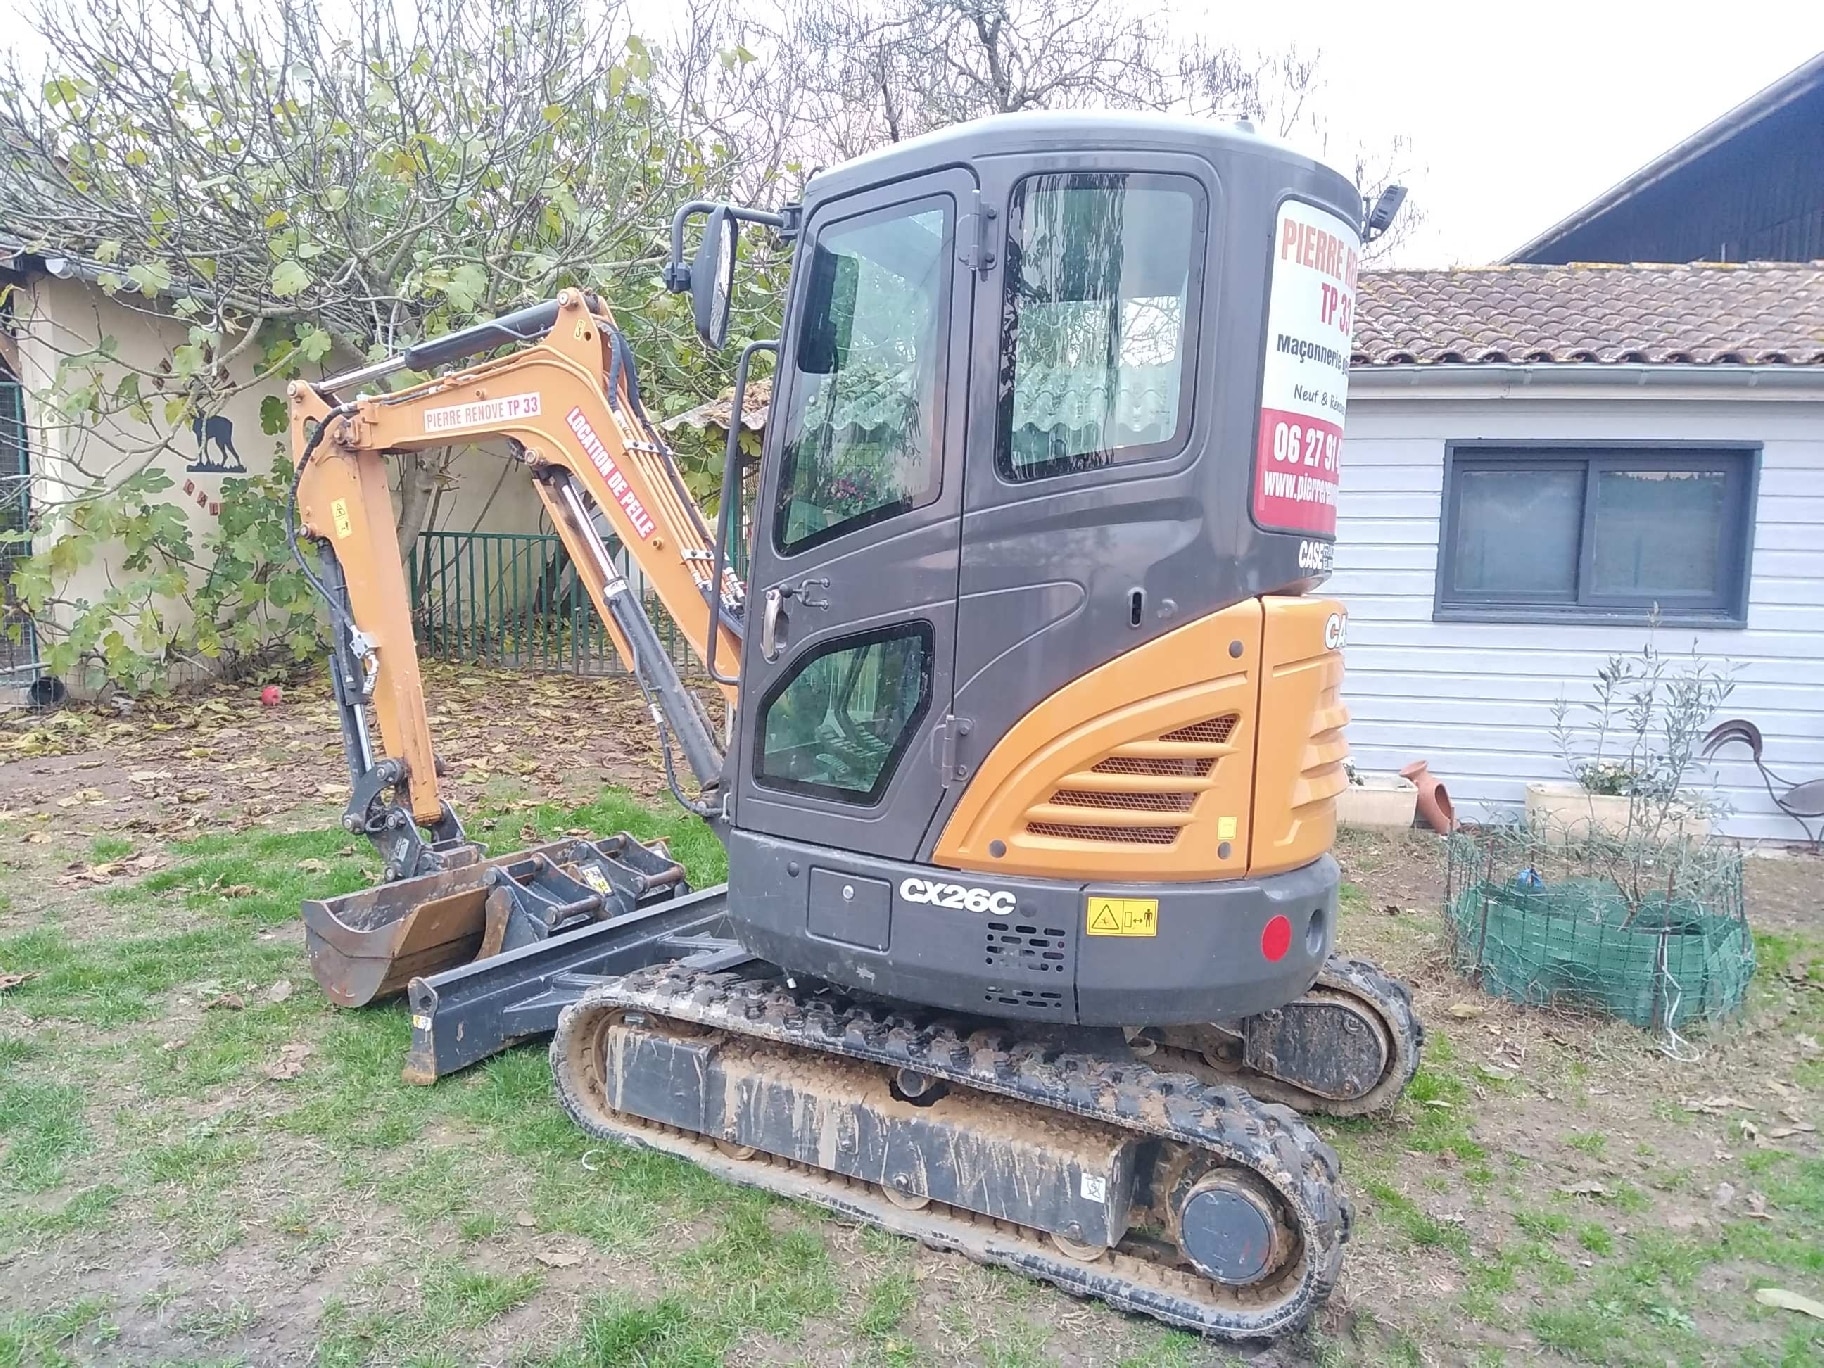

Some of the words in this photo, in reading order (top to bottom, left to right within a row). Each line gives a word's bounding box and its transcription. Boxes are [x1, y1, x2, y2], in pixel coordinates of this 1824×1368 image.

[1281, 218, 1344, 280] PIERRE
[1321, 282, 1338, 325] TP
[1339, 293, 1352, 336] 33
[1276, 333, 1342, 371] Maçonnerie
[426, 410, 462, 429] PIERRE
[465, 402, 504, 423] RENOVE
[507, 399, 520, 416] TP
[523, 396, 538, 414] 33
[1293, 383, 1319, 403] Neuf
[1321, 392, 1328, 406] &
[1274, 421, 1302, 464] 06
[1303, 428, 1325, 467] 27
[1324, 433, 1338, 473] 91
[566, 406, 616, 478] LOCATION
[607, 471, 628, 497] DE
[620, 491, 655, 538] PELLE
[1299, 540, 1324, 570] CASE
[899, 877, 1017, 915] CX26C
